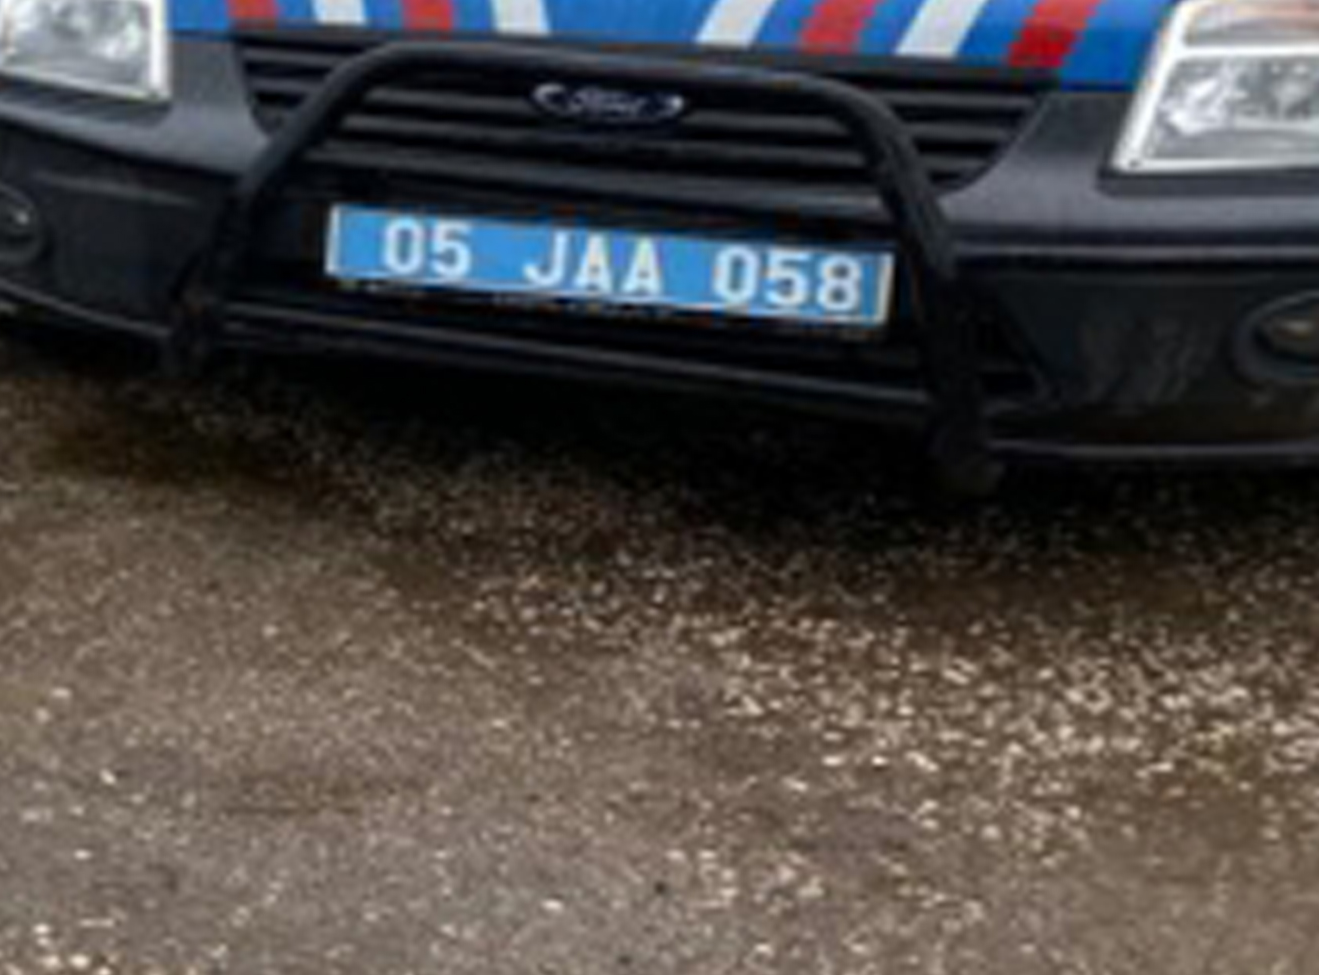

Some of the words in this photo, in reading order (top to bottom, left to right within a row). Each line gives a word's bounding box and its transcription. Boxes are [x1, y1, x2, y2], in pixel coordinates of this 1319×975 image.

[383, 217, 472, 277] 05
[523, 232, 662, 295] JAA
[712, 245, 862, 312] 058
